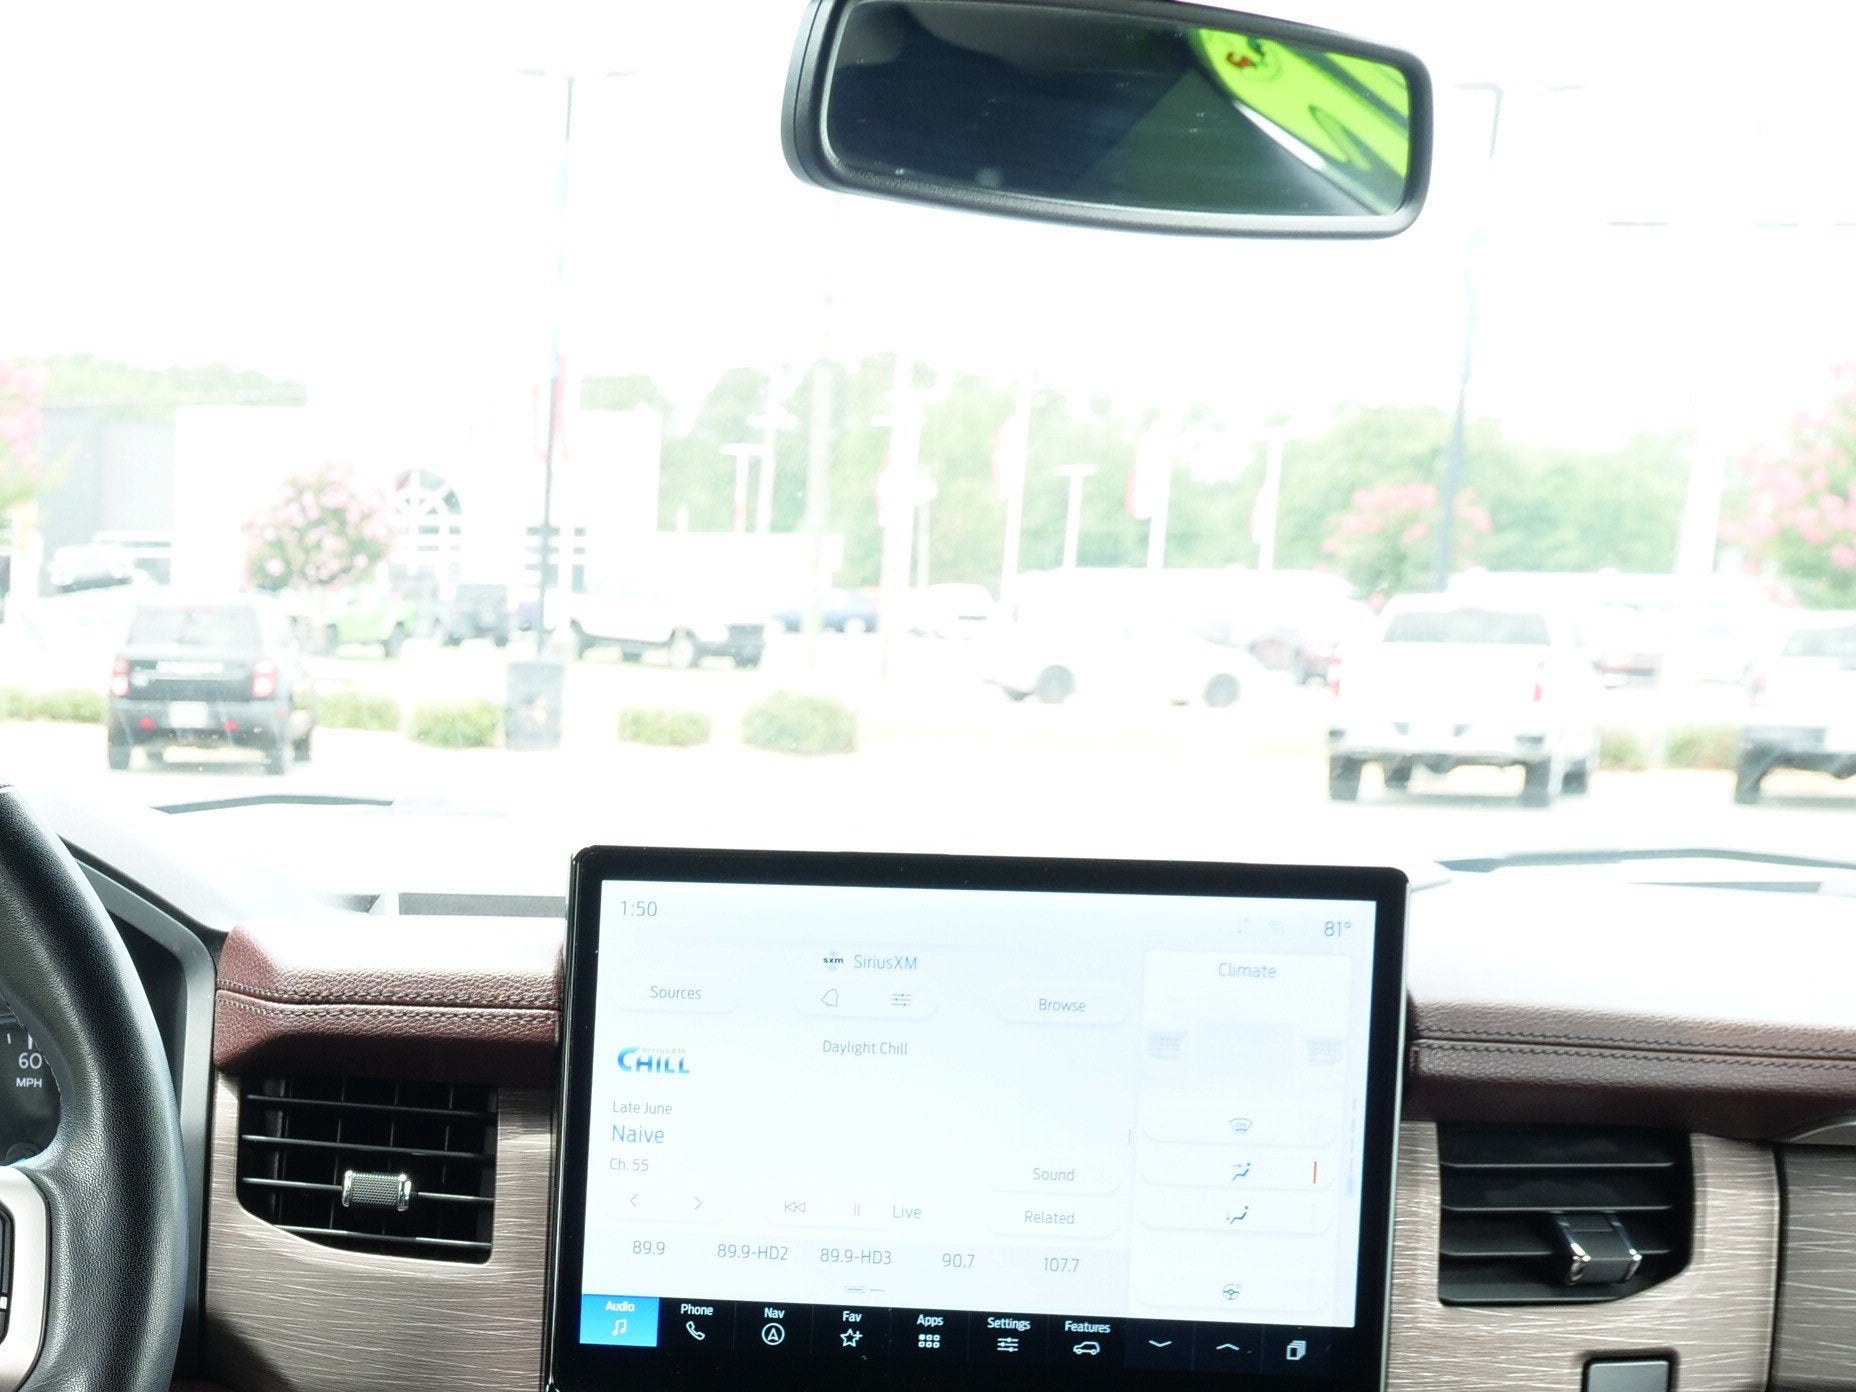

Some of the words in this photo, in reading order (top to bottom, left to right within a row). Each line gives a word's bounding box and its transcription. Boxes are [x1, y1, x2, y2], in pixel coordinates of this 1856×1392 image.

[621, 901, 657, 916] 1:50
[855, 955, 917, 969] SiriusXM
[1219, 963, 1276, 978] Climate
[651, 986, 701, 999] Sources
[1039, 998, 1085, 1011] Browse
[823, 1040, 876, 1057] Daylight
[880, 1042, 908, 1056] Chill
[18, 1052, 42, 1069] 60
[16, 1077, 42, 1088] MPH
[613, 1101, 640, 1113] Late
[644, 1103, 672, 1115] June
[611, 1125, 664, 1143] Naive
[610, 1158, 628, 1170] Ch.
[633, 1159, 648, 1171] 55
[1033, 1168, 1074, 1181] Sound
[893, 1205, 921, 1219] Live
[1025, 1211, 1074, 1224] Related
[633, 1241, 665, 1254] 89.9
[718, 1244, 787, 1260] 89.9-HD2
[821, 1249, 891, 1264] 89.9-HD3
[943, 1254, 974, 1267] 90.7
[1045, 1258, 1079, 1272] 107.7
[605, 1301, 635, 1313] Audio
[681, 1304, 713, 1315] Phone
[765, 1307, 785, 1319] Nav
[843, 1311, 862, 1322] Fav
[917, 1314, 943, 1327] Apps
[988, 1317, 1031, 1333] Settings
[1065, 1321, 1111, 1334] Features
